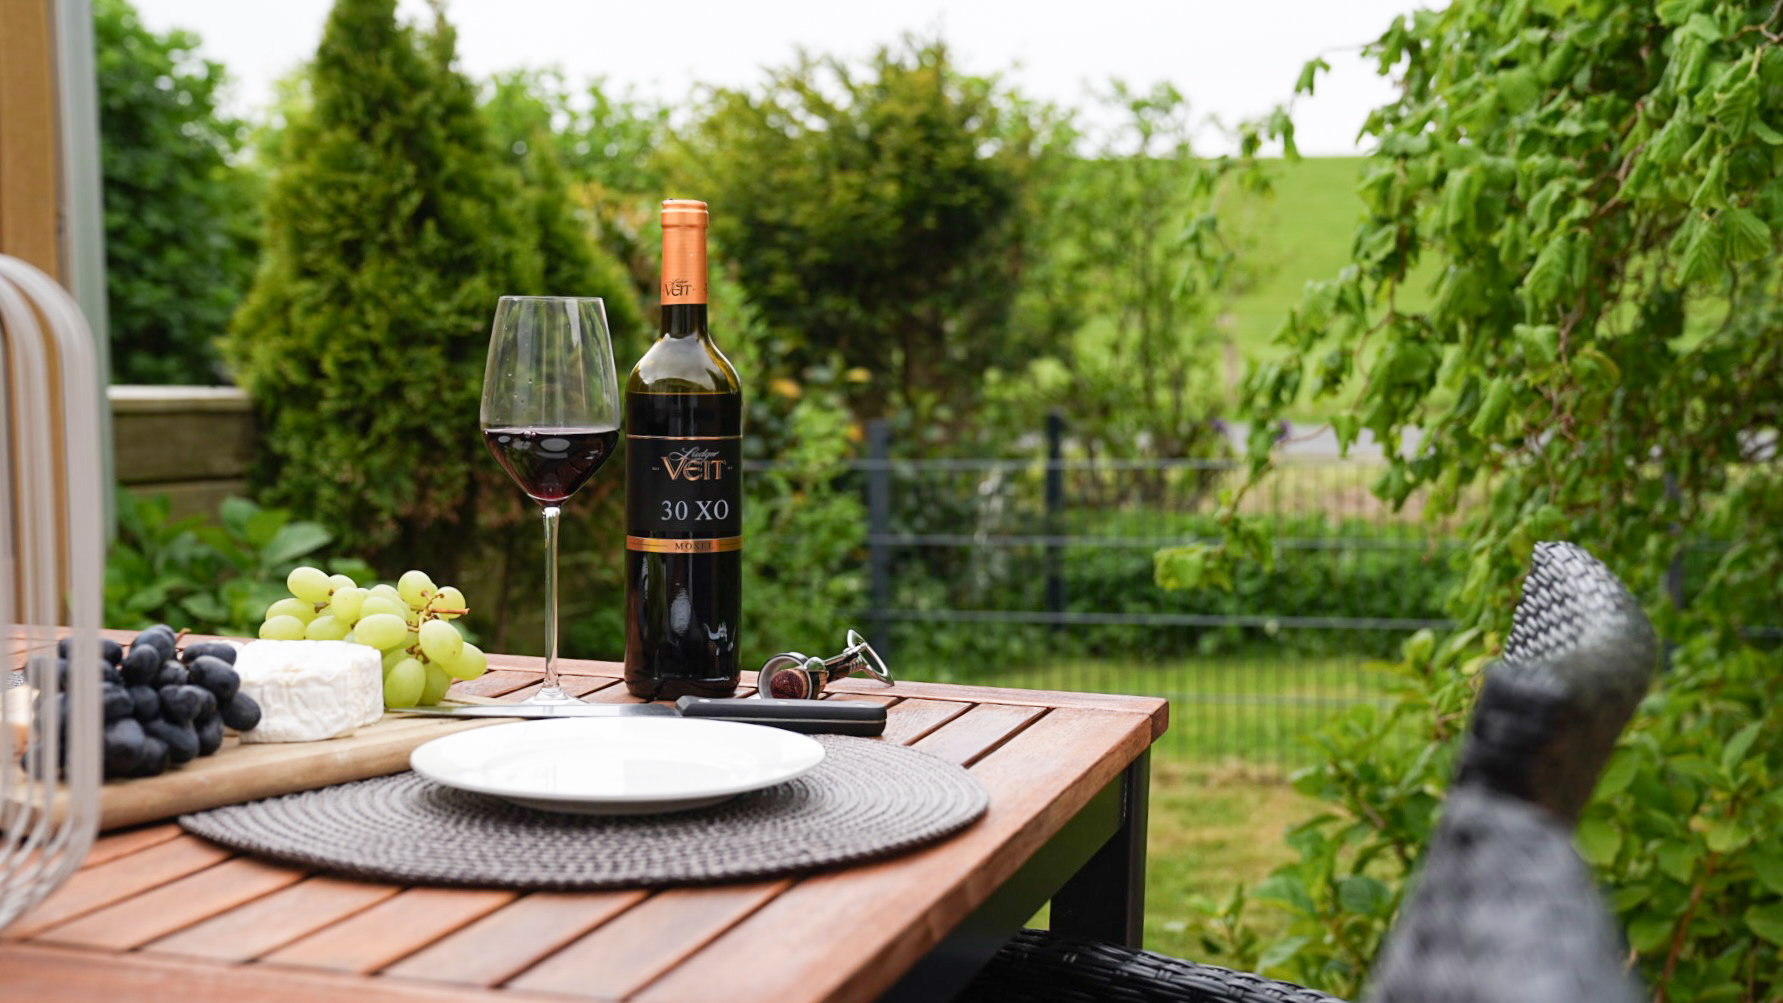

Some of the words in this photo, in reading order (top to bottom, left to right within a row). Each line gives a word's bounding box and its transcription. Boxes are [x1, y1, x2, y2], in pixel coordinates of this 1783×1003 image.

[661, 500, 688, 521] 30
[695, 499, 729, 520] XO
[675, 542, 714, 551] MOSEL
